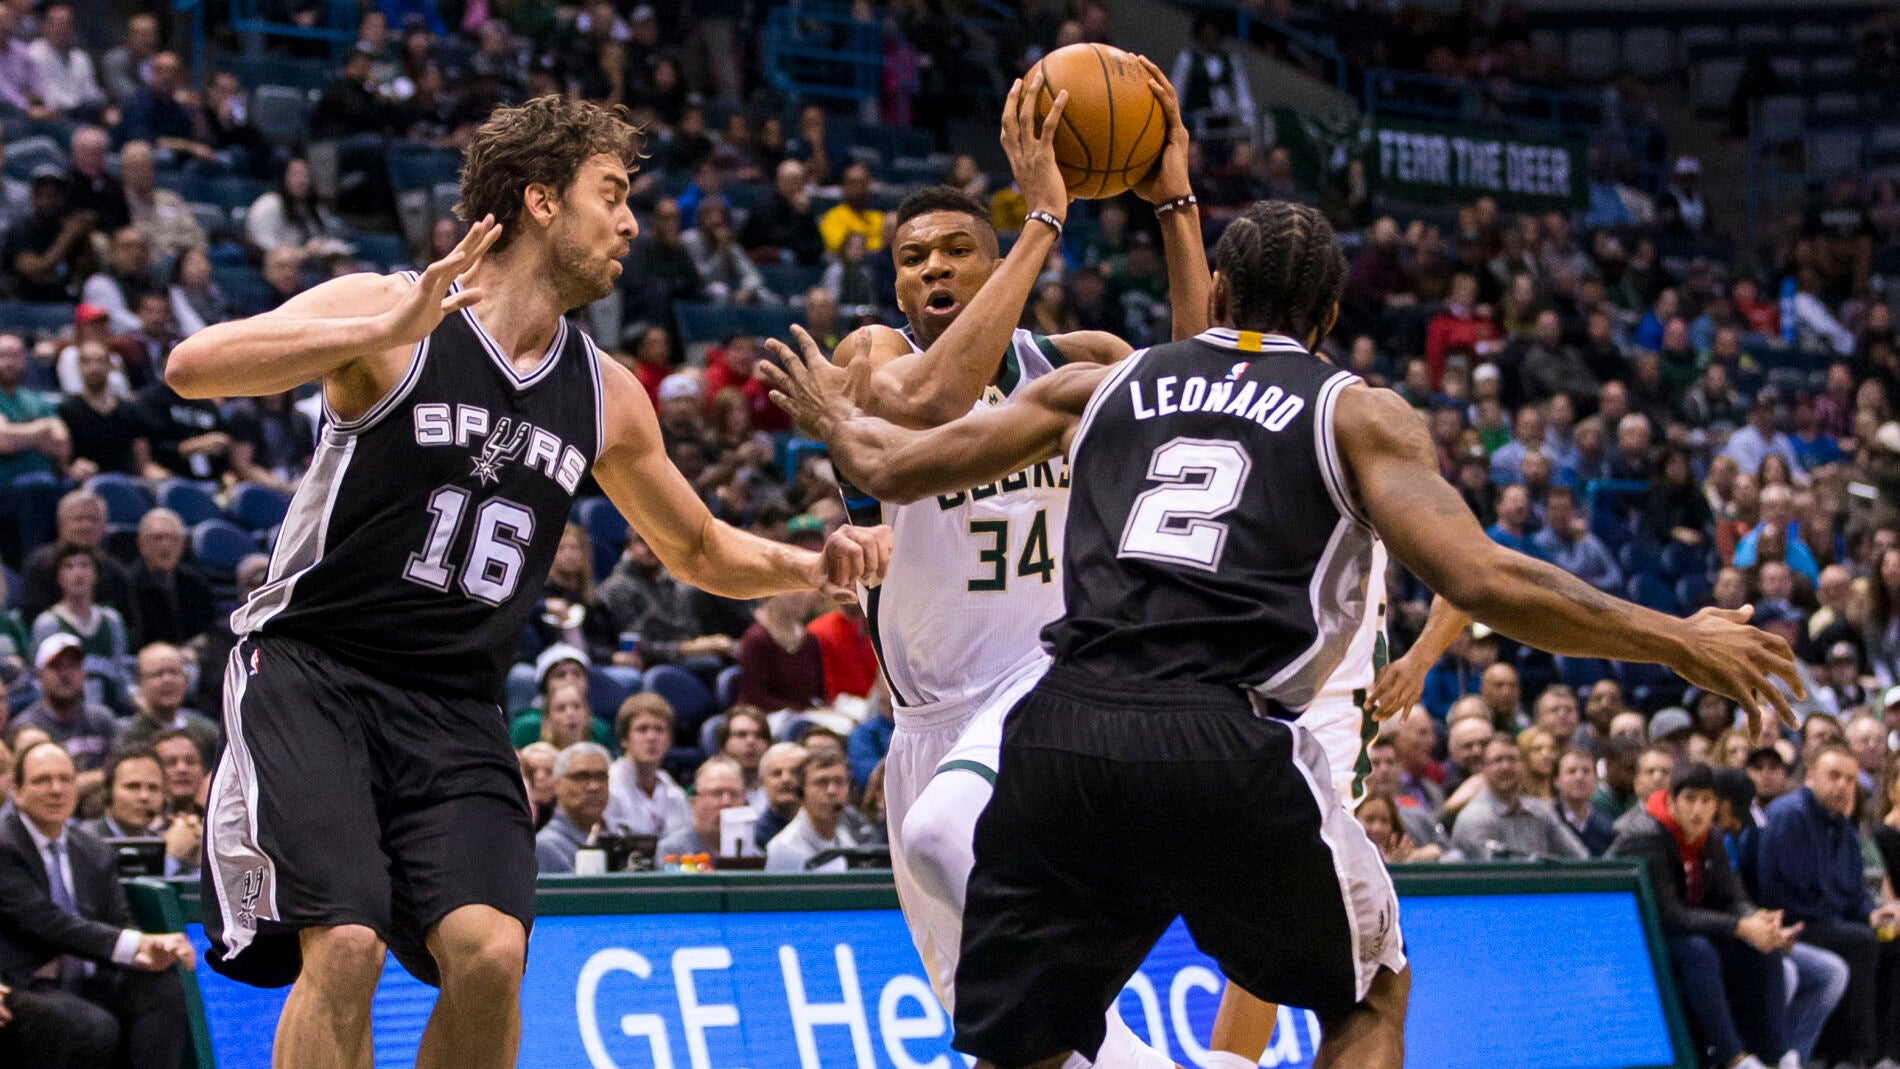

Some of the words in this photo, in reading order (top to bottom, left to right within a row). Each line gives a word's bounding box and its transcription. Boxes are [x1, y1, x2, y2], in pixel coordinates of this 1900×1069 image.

[1379, 129, 1449, 184] FEAR
[1452, 137, 1501, 190] THE
[1506, 143, 1570, 197] DEER
[1129, 375, 1305, 432] LEONARD
[413, 403, 587, 496] SPURS
[402, 484, 536, 607] 16
[1116, 436, 1252, 573] 2
[967, 508, 1056, 592] 34
